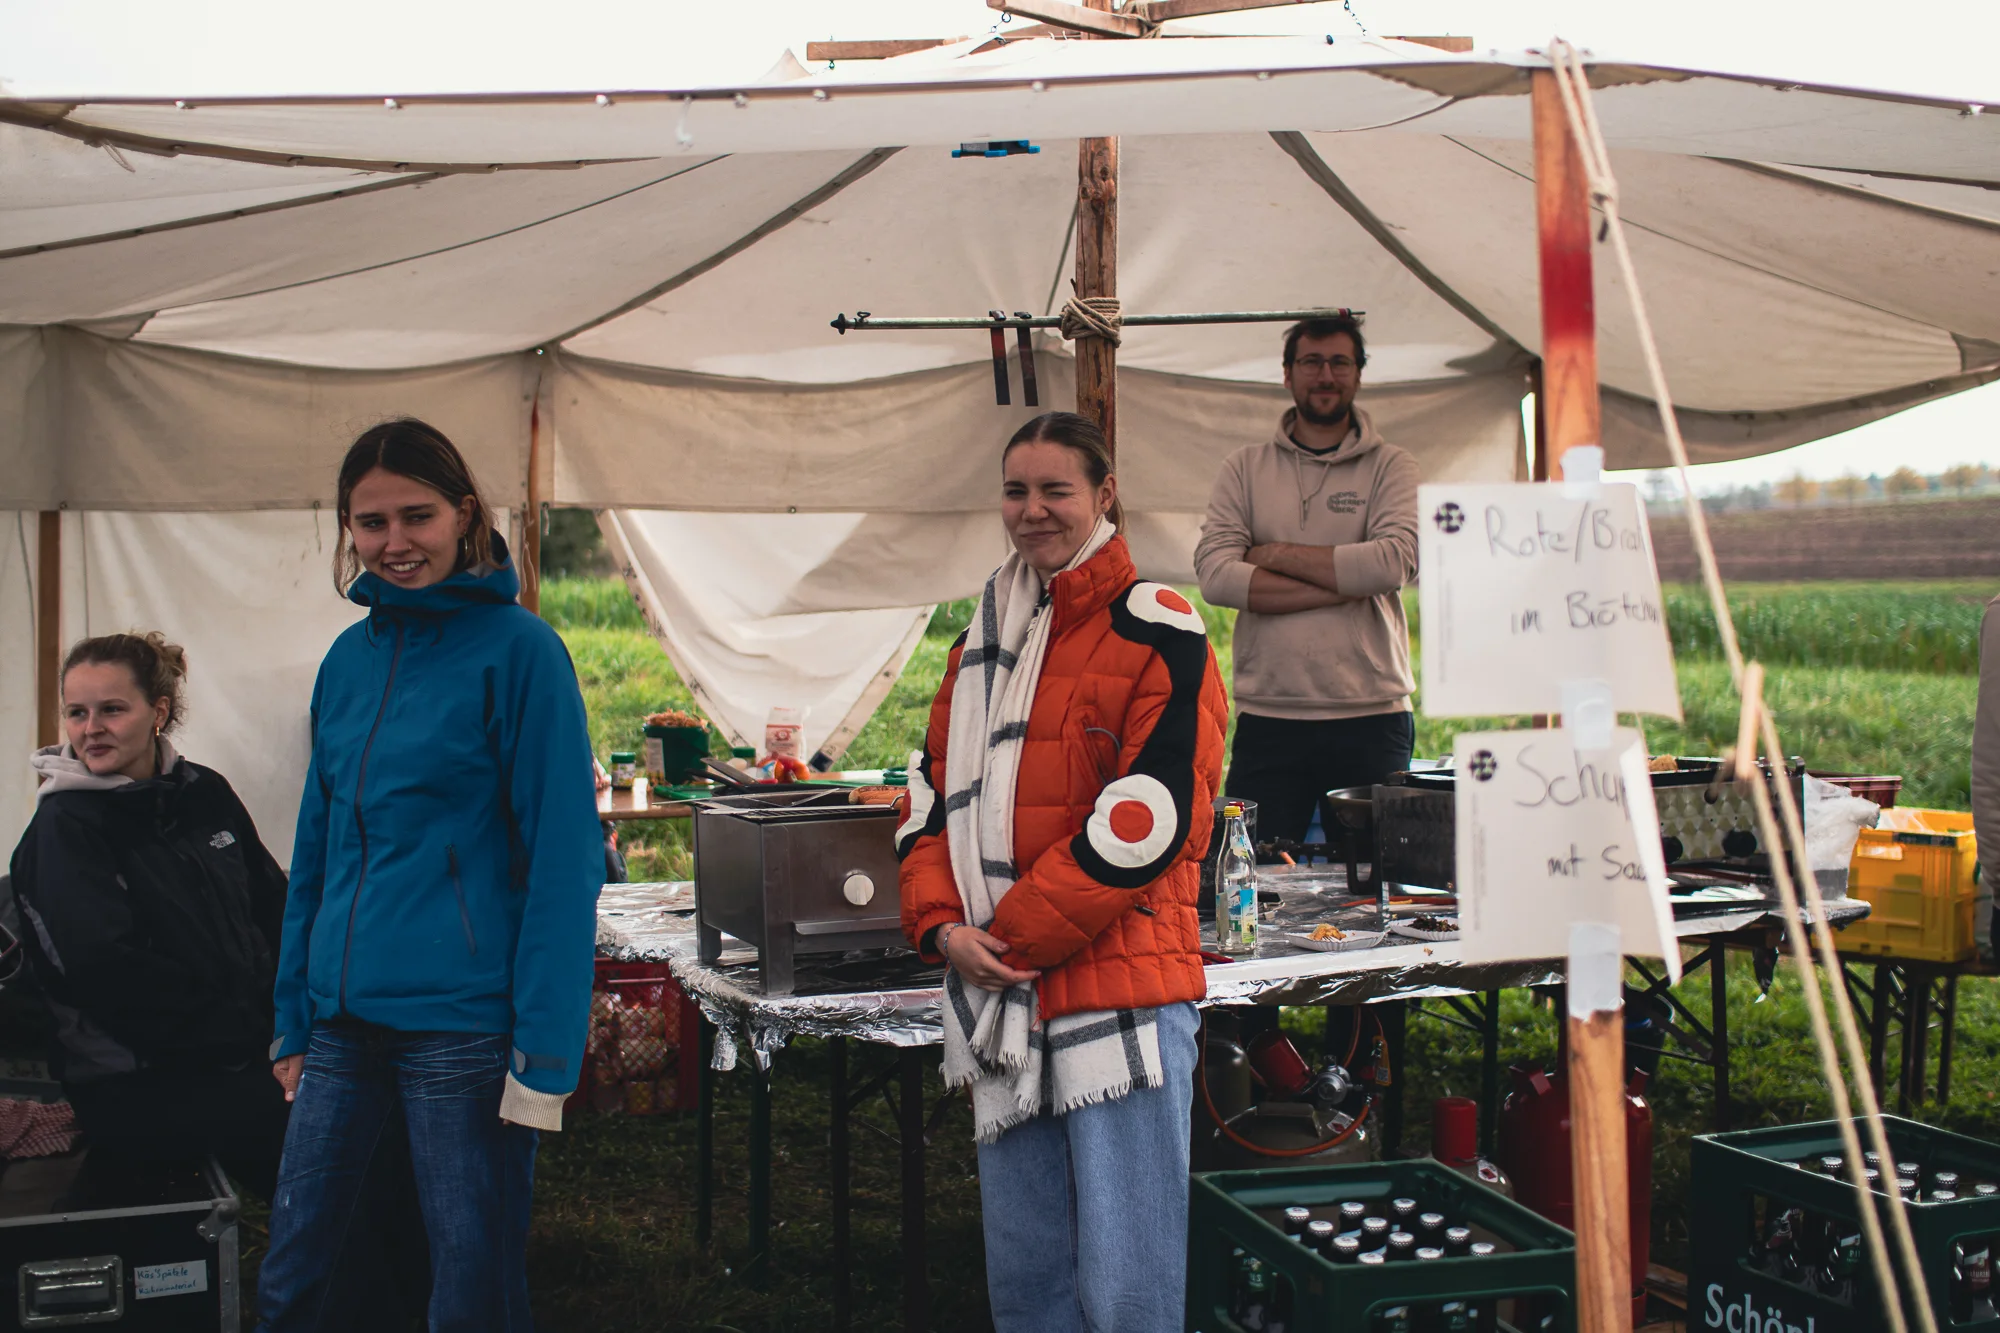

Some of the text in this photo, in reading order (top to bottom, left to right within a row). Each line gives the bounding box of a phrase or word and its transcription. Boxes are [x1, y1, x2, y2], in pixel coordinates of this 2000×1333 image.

[1510, 608, 1542, 635] im
[1547, 843, 1648, 881] mit Sau
[1705, 1282, 1815, 1333] Schö
